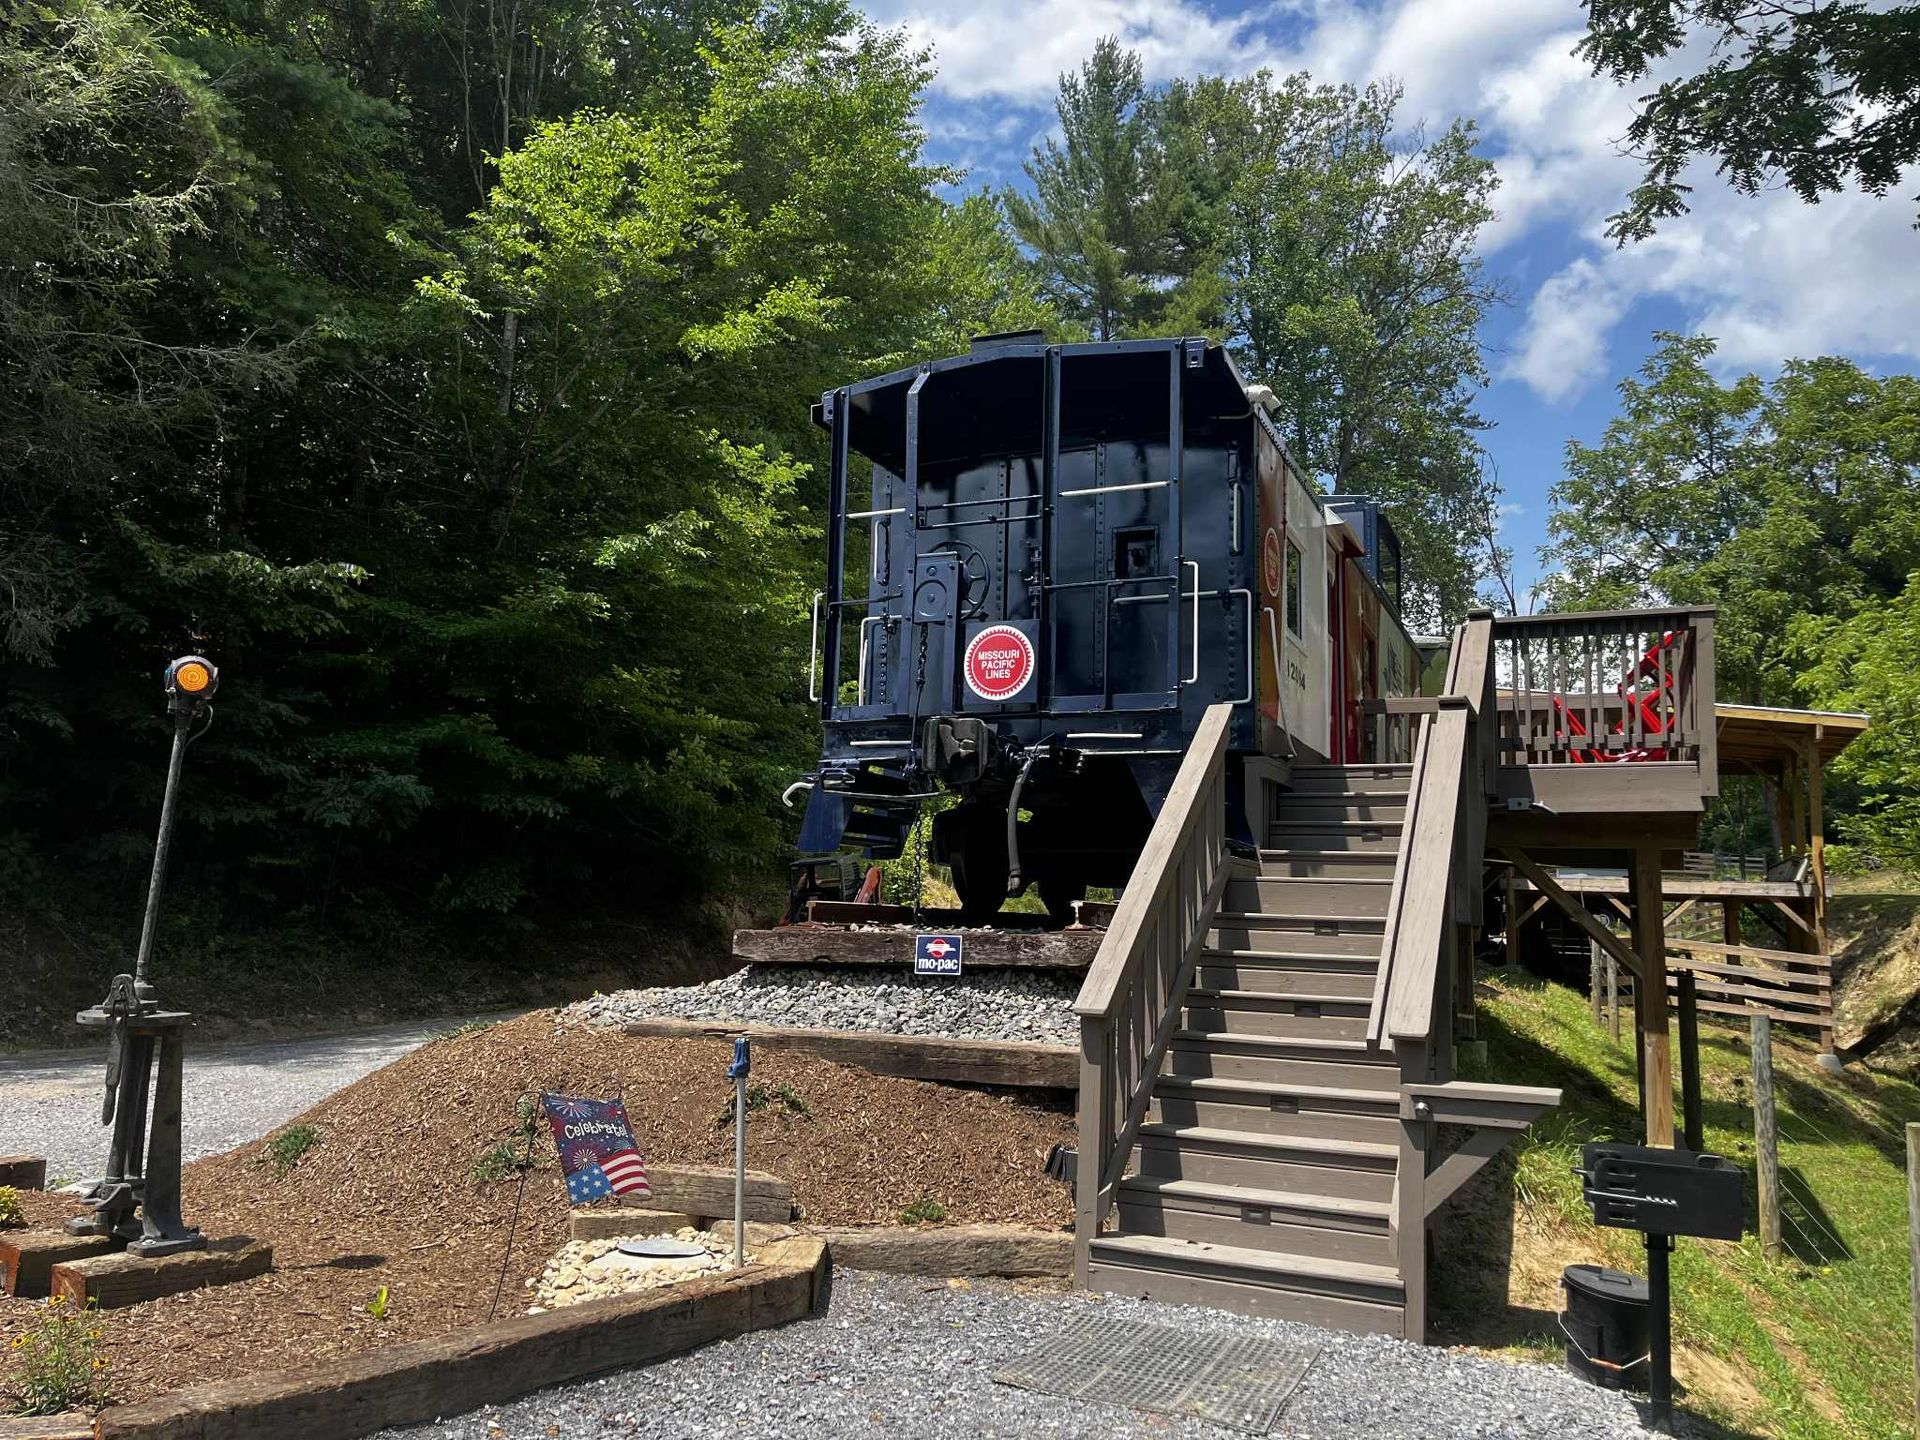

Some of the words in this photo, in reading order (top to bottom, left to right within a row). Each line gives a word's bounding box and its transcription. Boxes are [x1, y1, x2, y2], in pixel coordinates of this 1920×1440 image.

[978, 650, 1020, 660] MISSOURI
[981, 660, 1015, 670] PACIFIC
[985, 669, 1011, 679] LINES
[564, 1121, 629, 1139] Celebrate!
